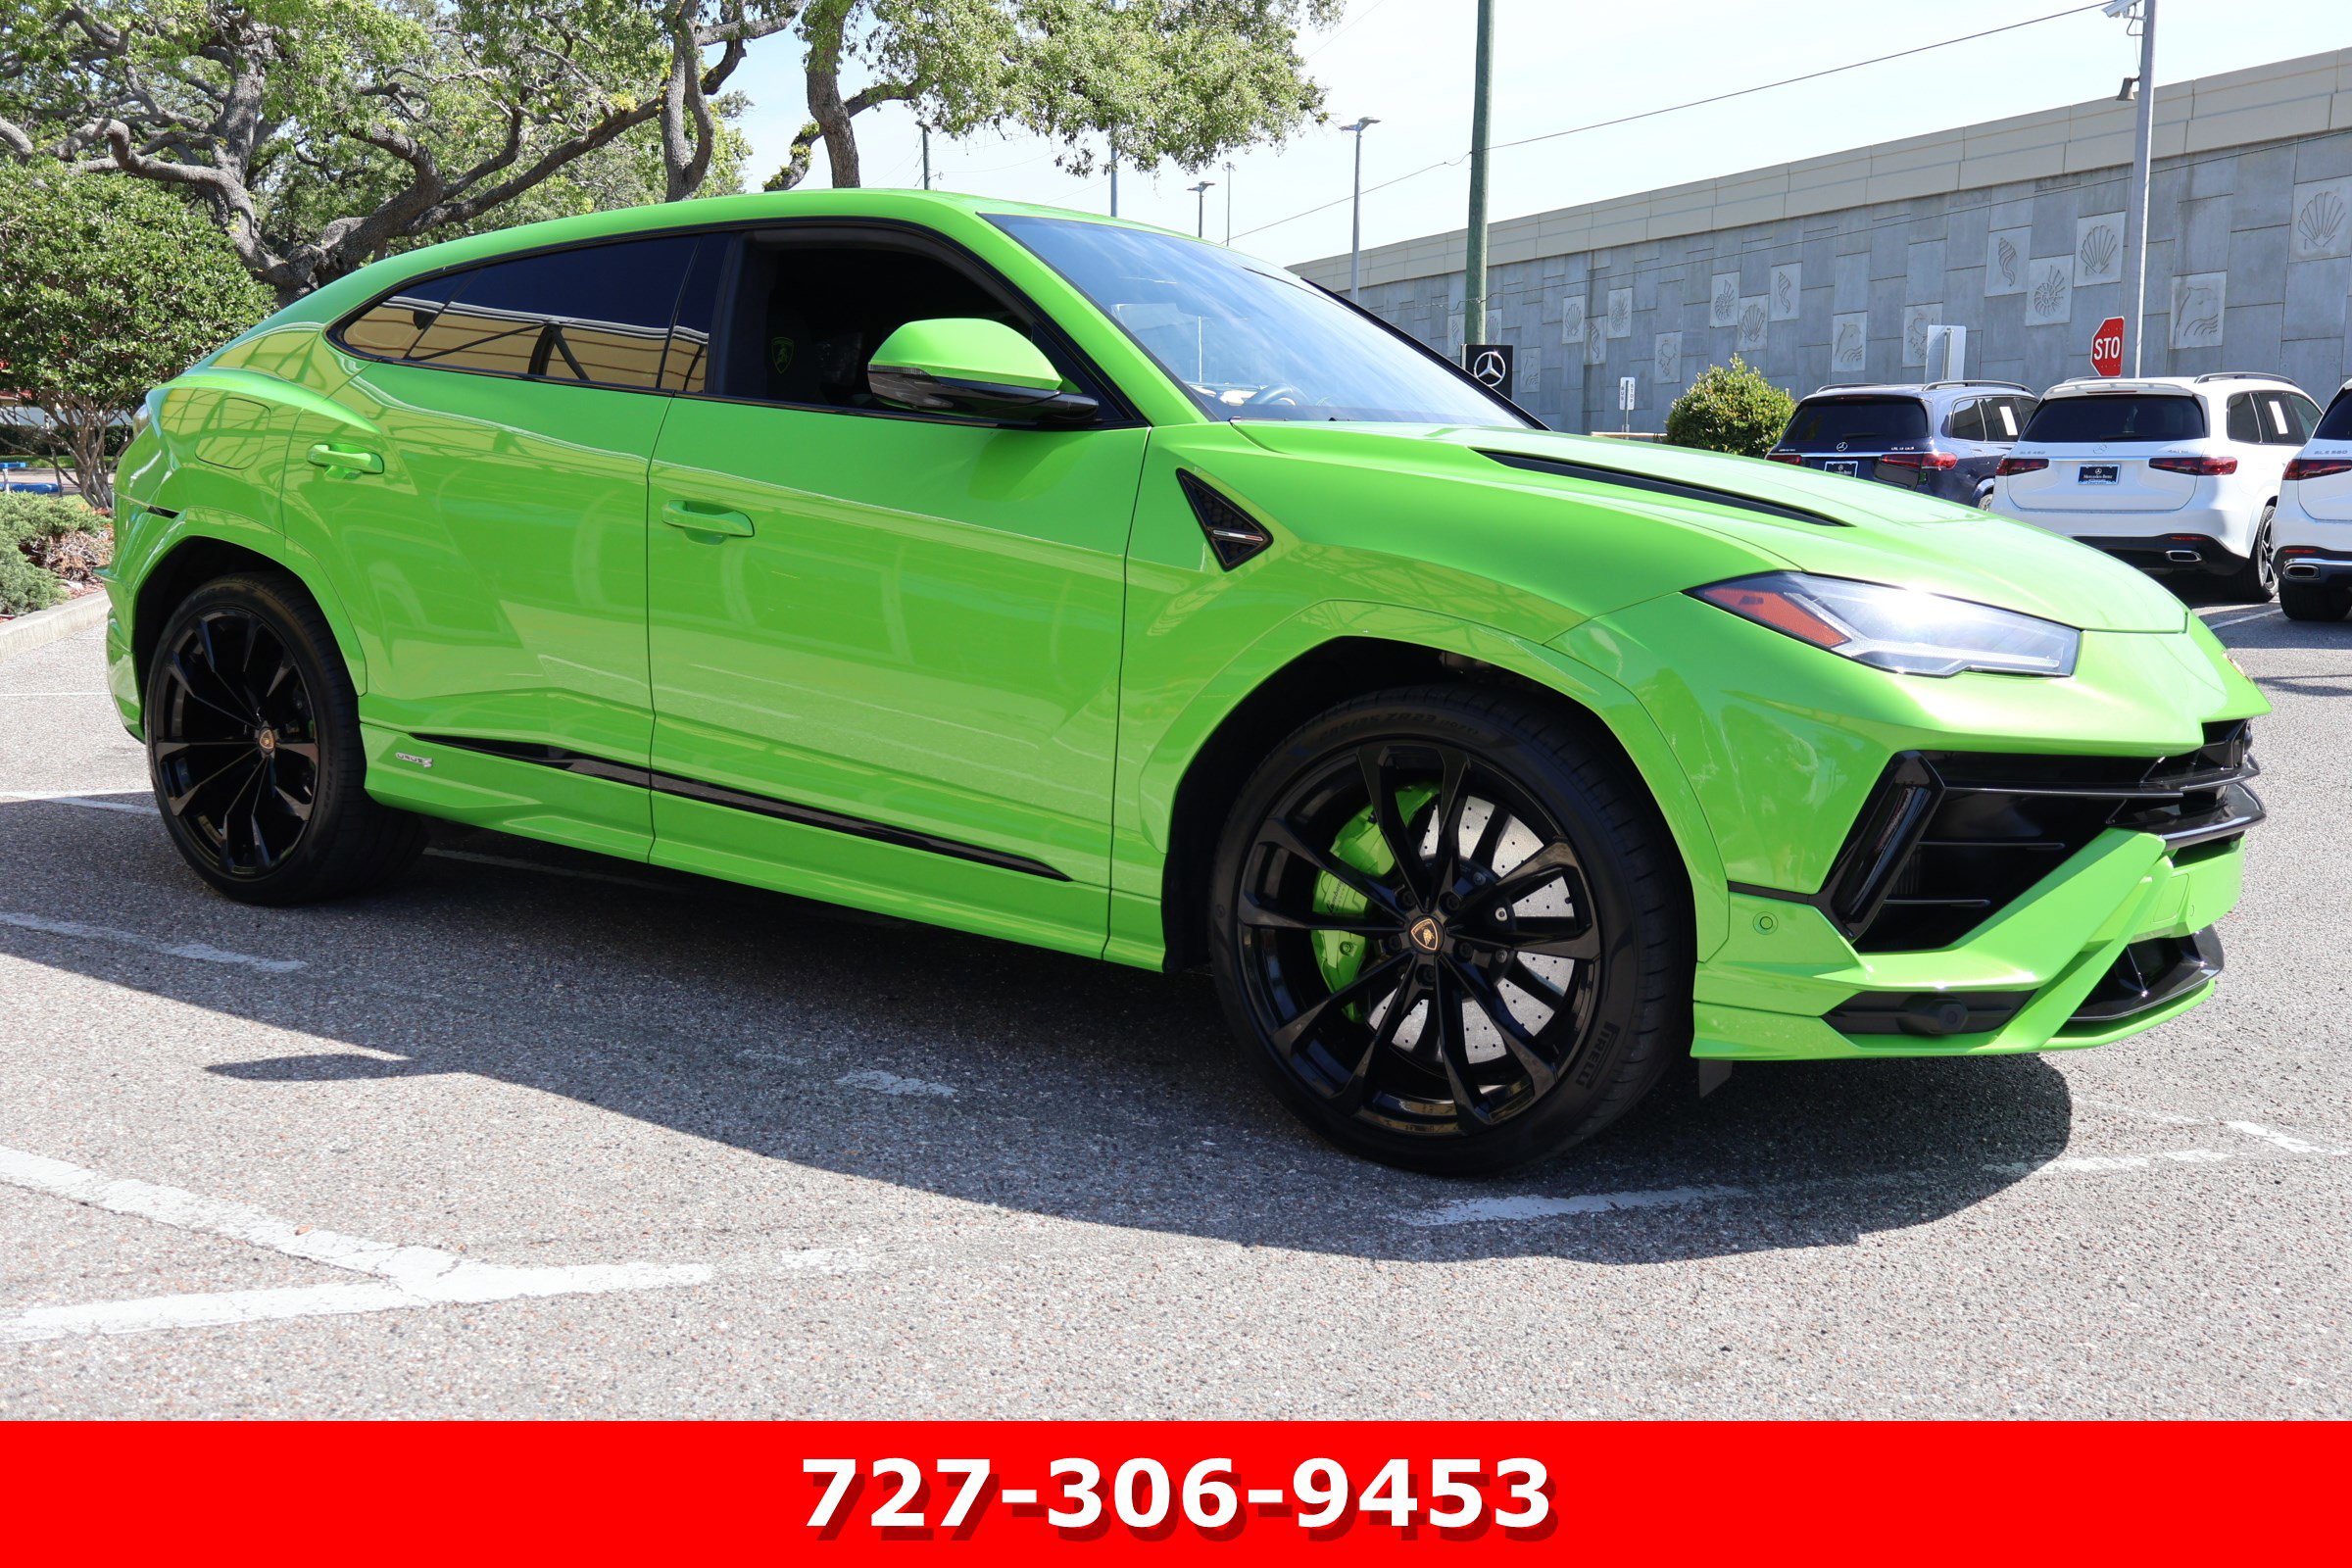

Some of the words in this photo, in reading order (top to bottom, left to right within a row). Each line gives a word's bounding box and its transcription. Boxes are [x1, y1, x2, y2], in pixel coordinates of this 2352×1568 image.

[2093, 336, 2121, 361] STO
[1326, 880, 1346, 913] Lambor
[1576, 1021, 1621, 1090] PIRELLI
